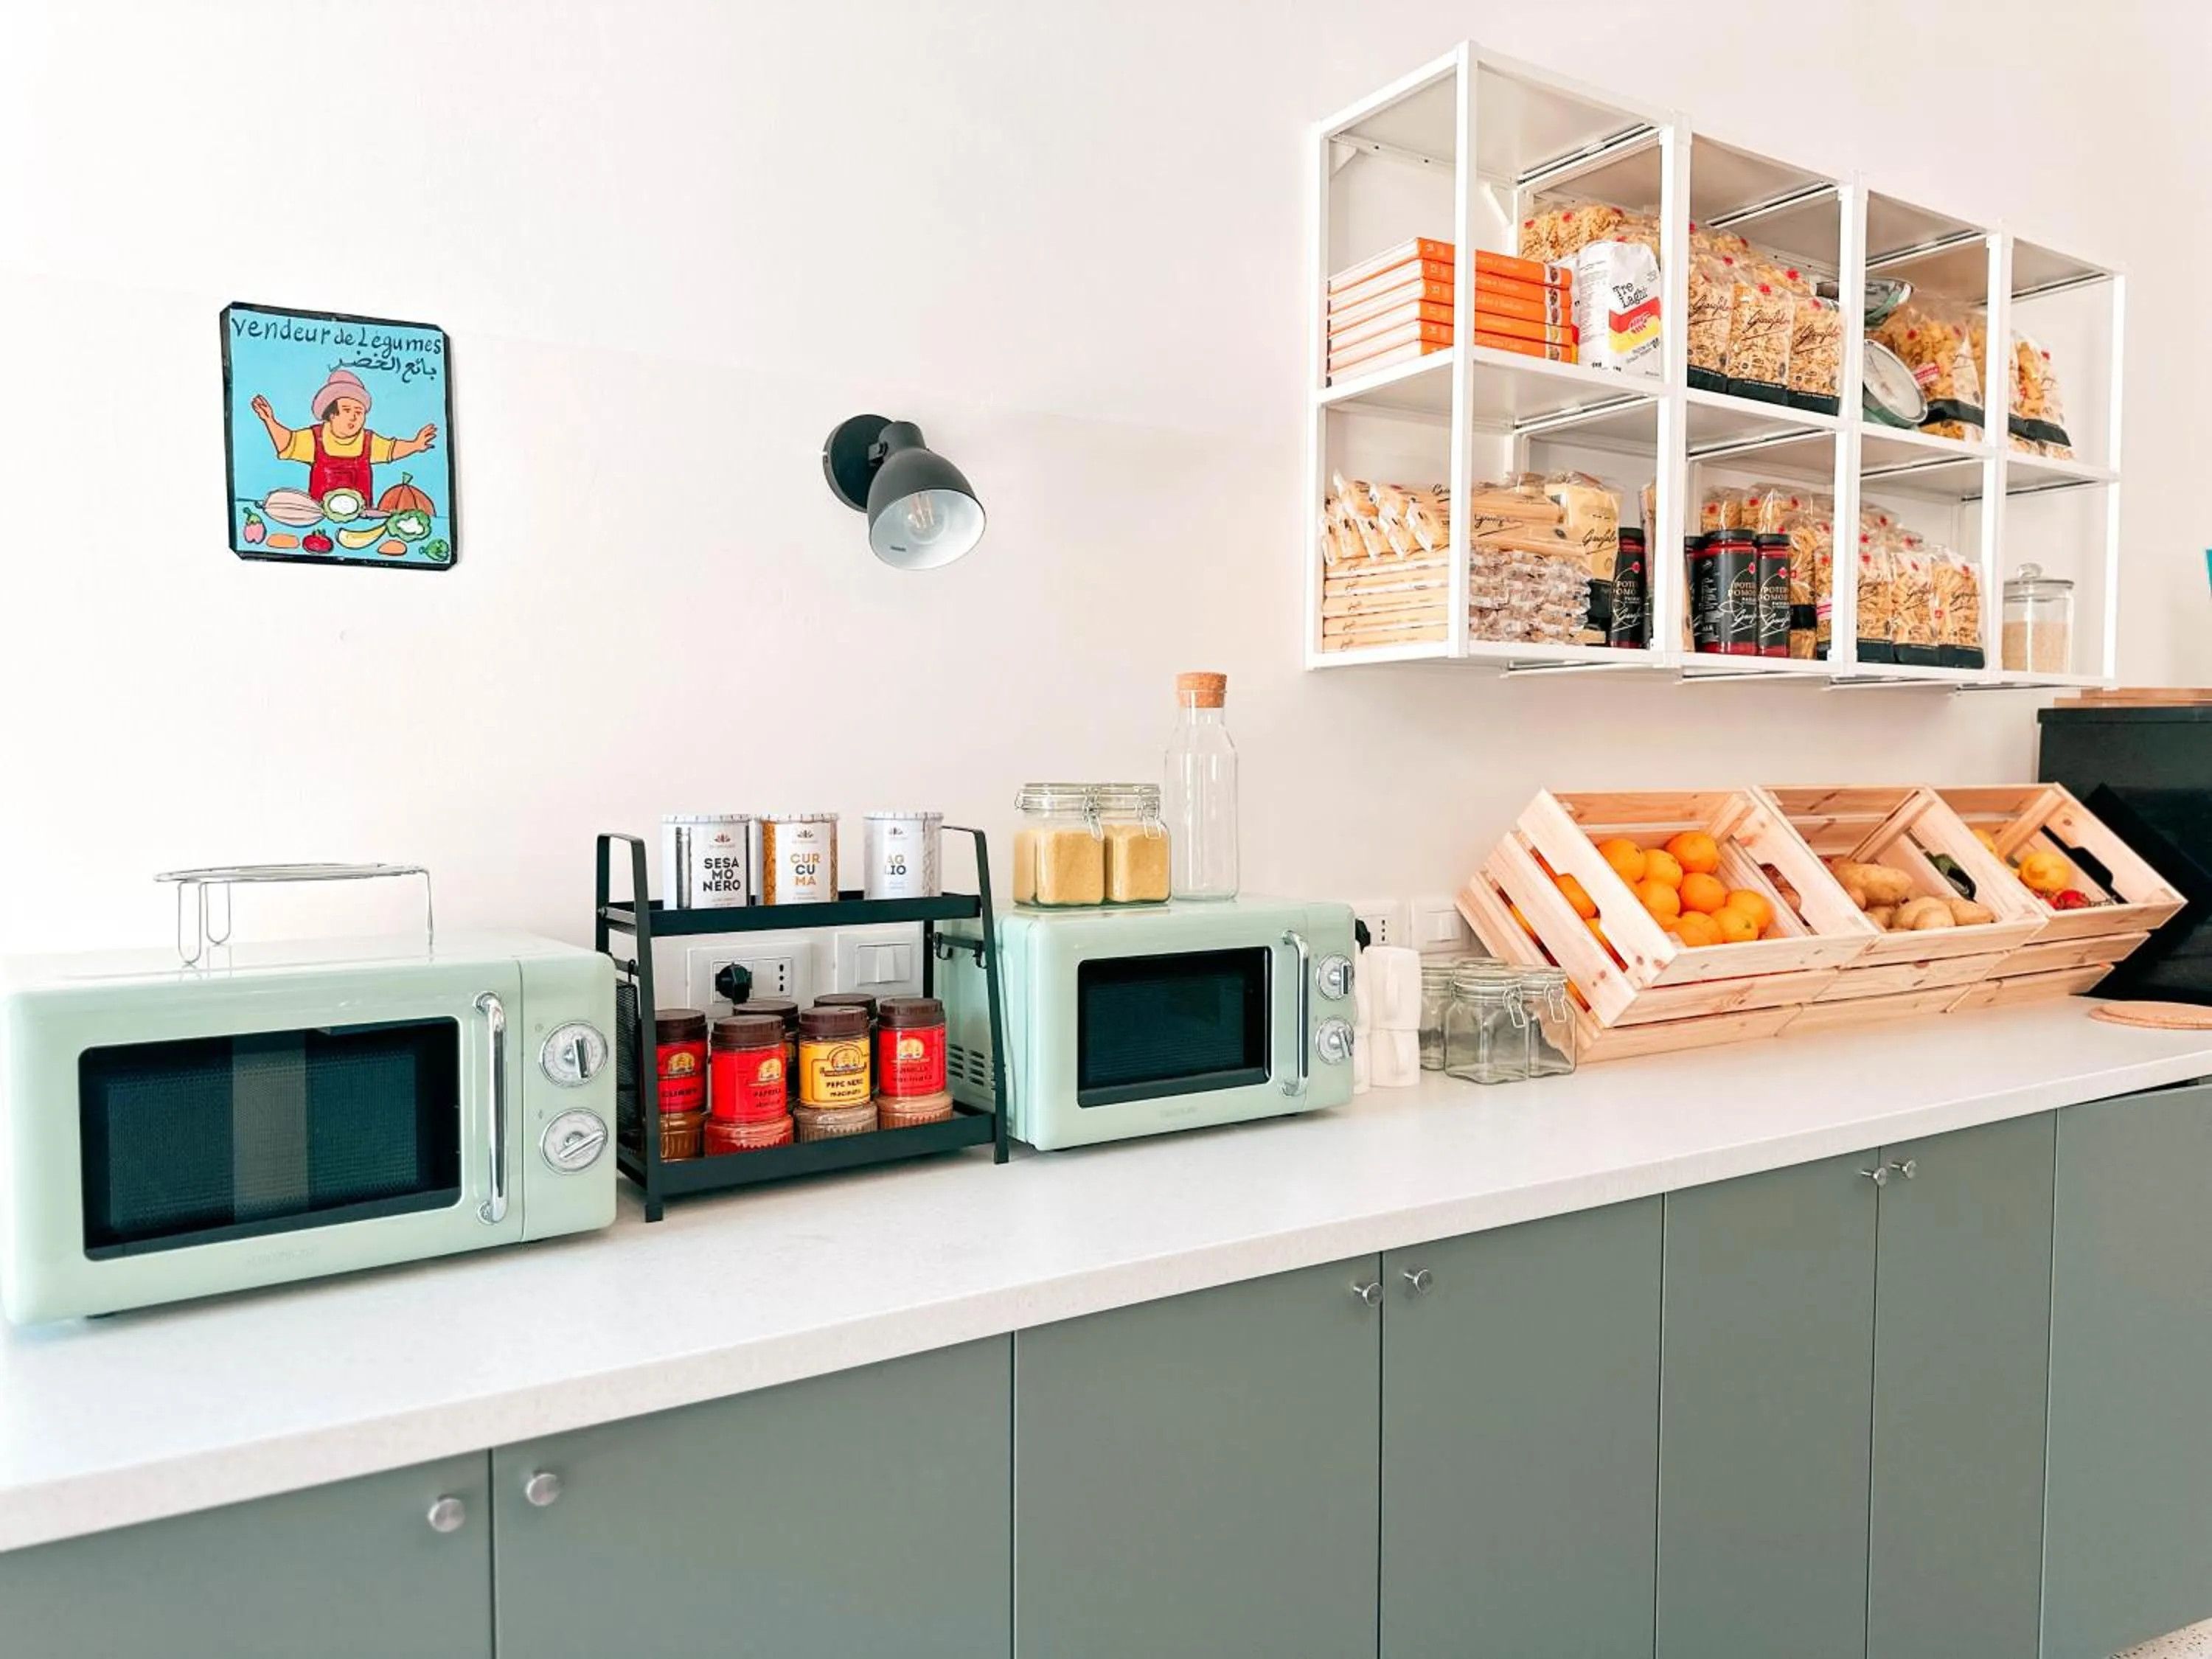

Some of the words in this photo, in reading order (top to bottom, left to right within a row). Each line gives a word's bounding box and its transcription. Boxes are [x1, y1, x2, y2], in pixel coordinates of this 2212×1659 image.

[1613, 282, 1634, 296] Tre
[334, 328, 355, 346] de
[703, 856, 740, 869] SESA
[790, 853, 821, 864] CUR
[712, 869, 734, 880] MO
[796, 864, 815, 875] CU
[703, 880, 741, 892] NERO
[796, 875, 817, 886] MA
